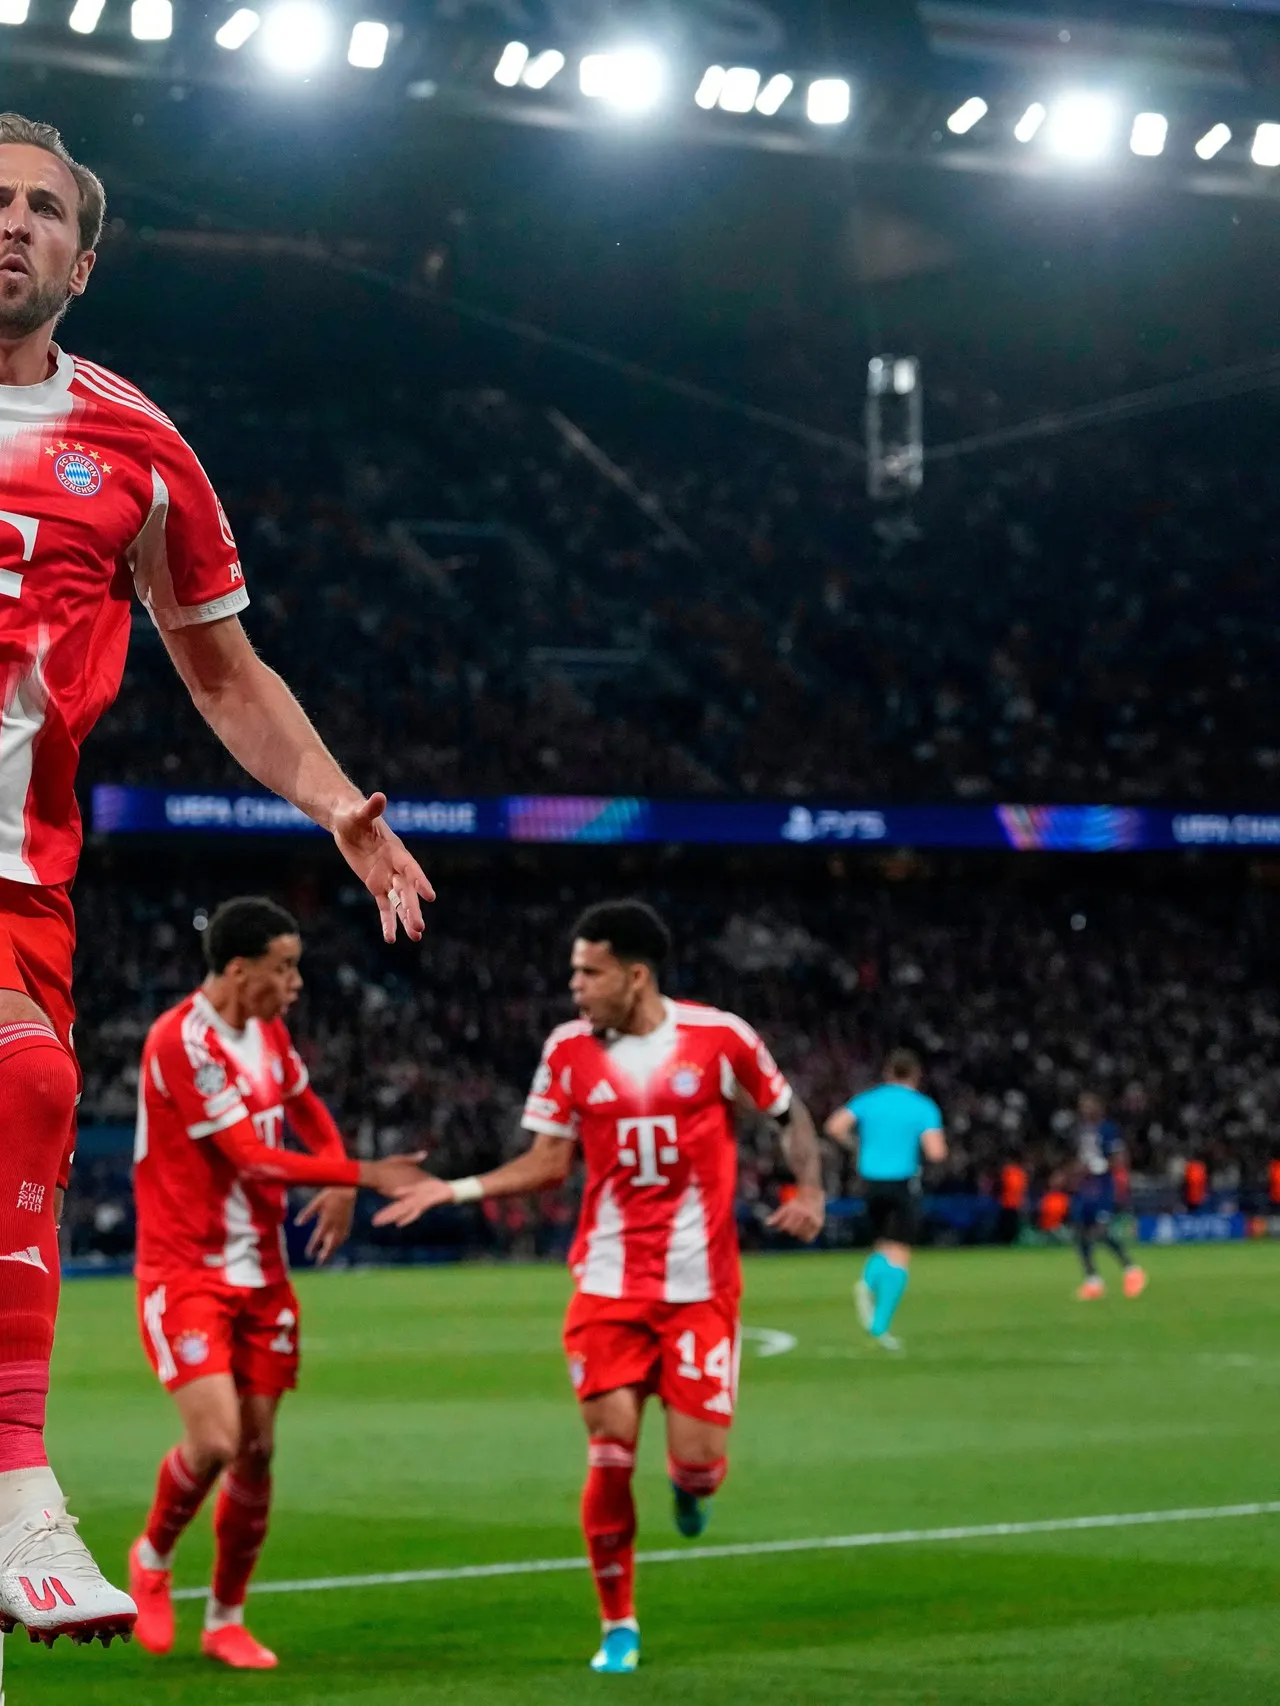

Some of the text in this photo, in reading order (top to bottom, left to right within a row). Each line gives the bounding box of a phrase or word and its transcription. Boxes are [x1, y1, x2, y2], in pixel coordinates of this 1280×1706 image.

[59, 455, 98, 477] FC BAYERN
[616, 1114, 679, 1187] T
[20, 1180, 45, 1195] MIA
[16, 1198, 42, 1214] MIA
[18, 1190, 44, 1205] SAN
[676, 1329, 731, 1389] 14
